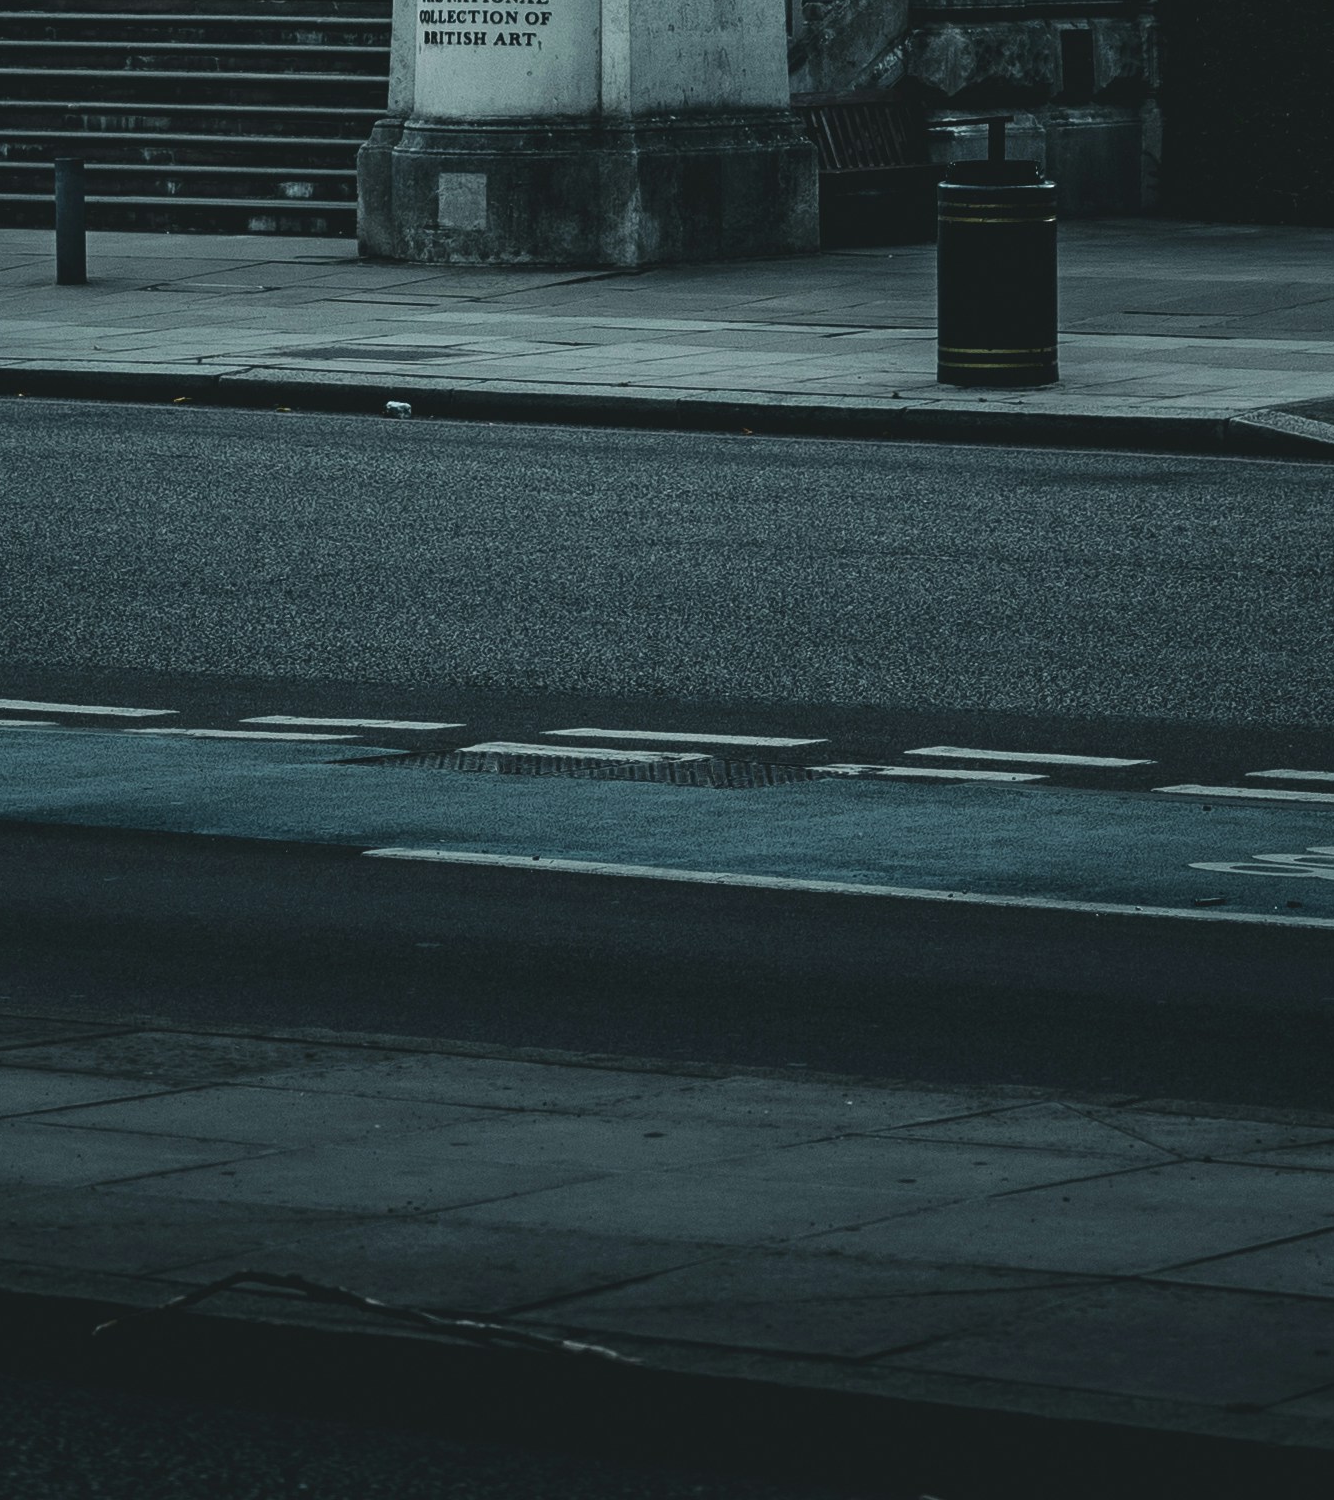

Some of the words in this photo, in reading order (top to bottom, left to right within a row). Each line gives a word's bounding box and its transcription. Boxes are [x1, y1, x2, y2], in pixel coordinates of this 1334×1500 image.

[419, 9, 519, 25] COLLECTION
[524, 10, 553, 26] OF
[424, 30, 487, 46] BRITISH
[493, 32, 537, 47] ART
